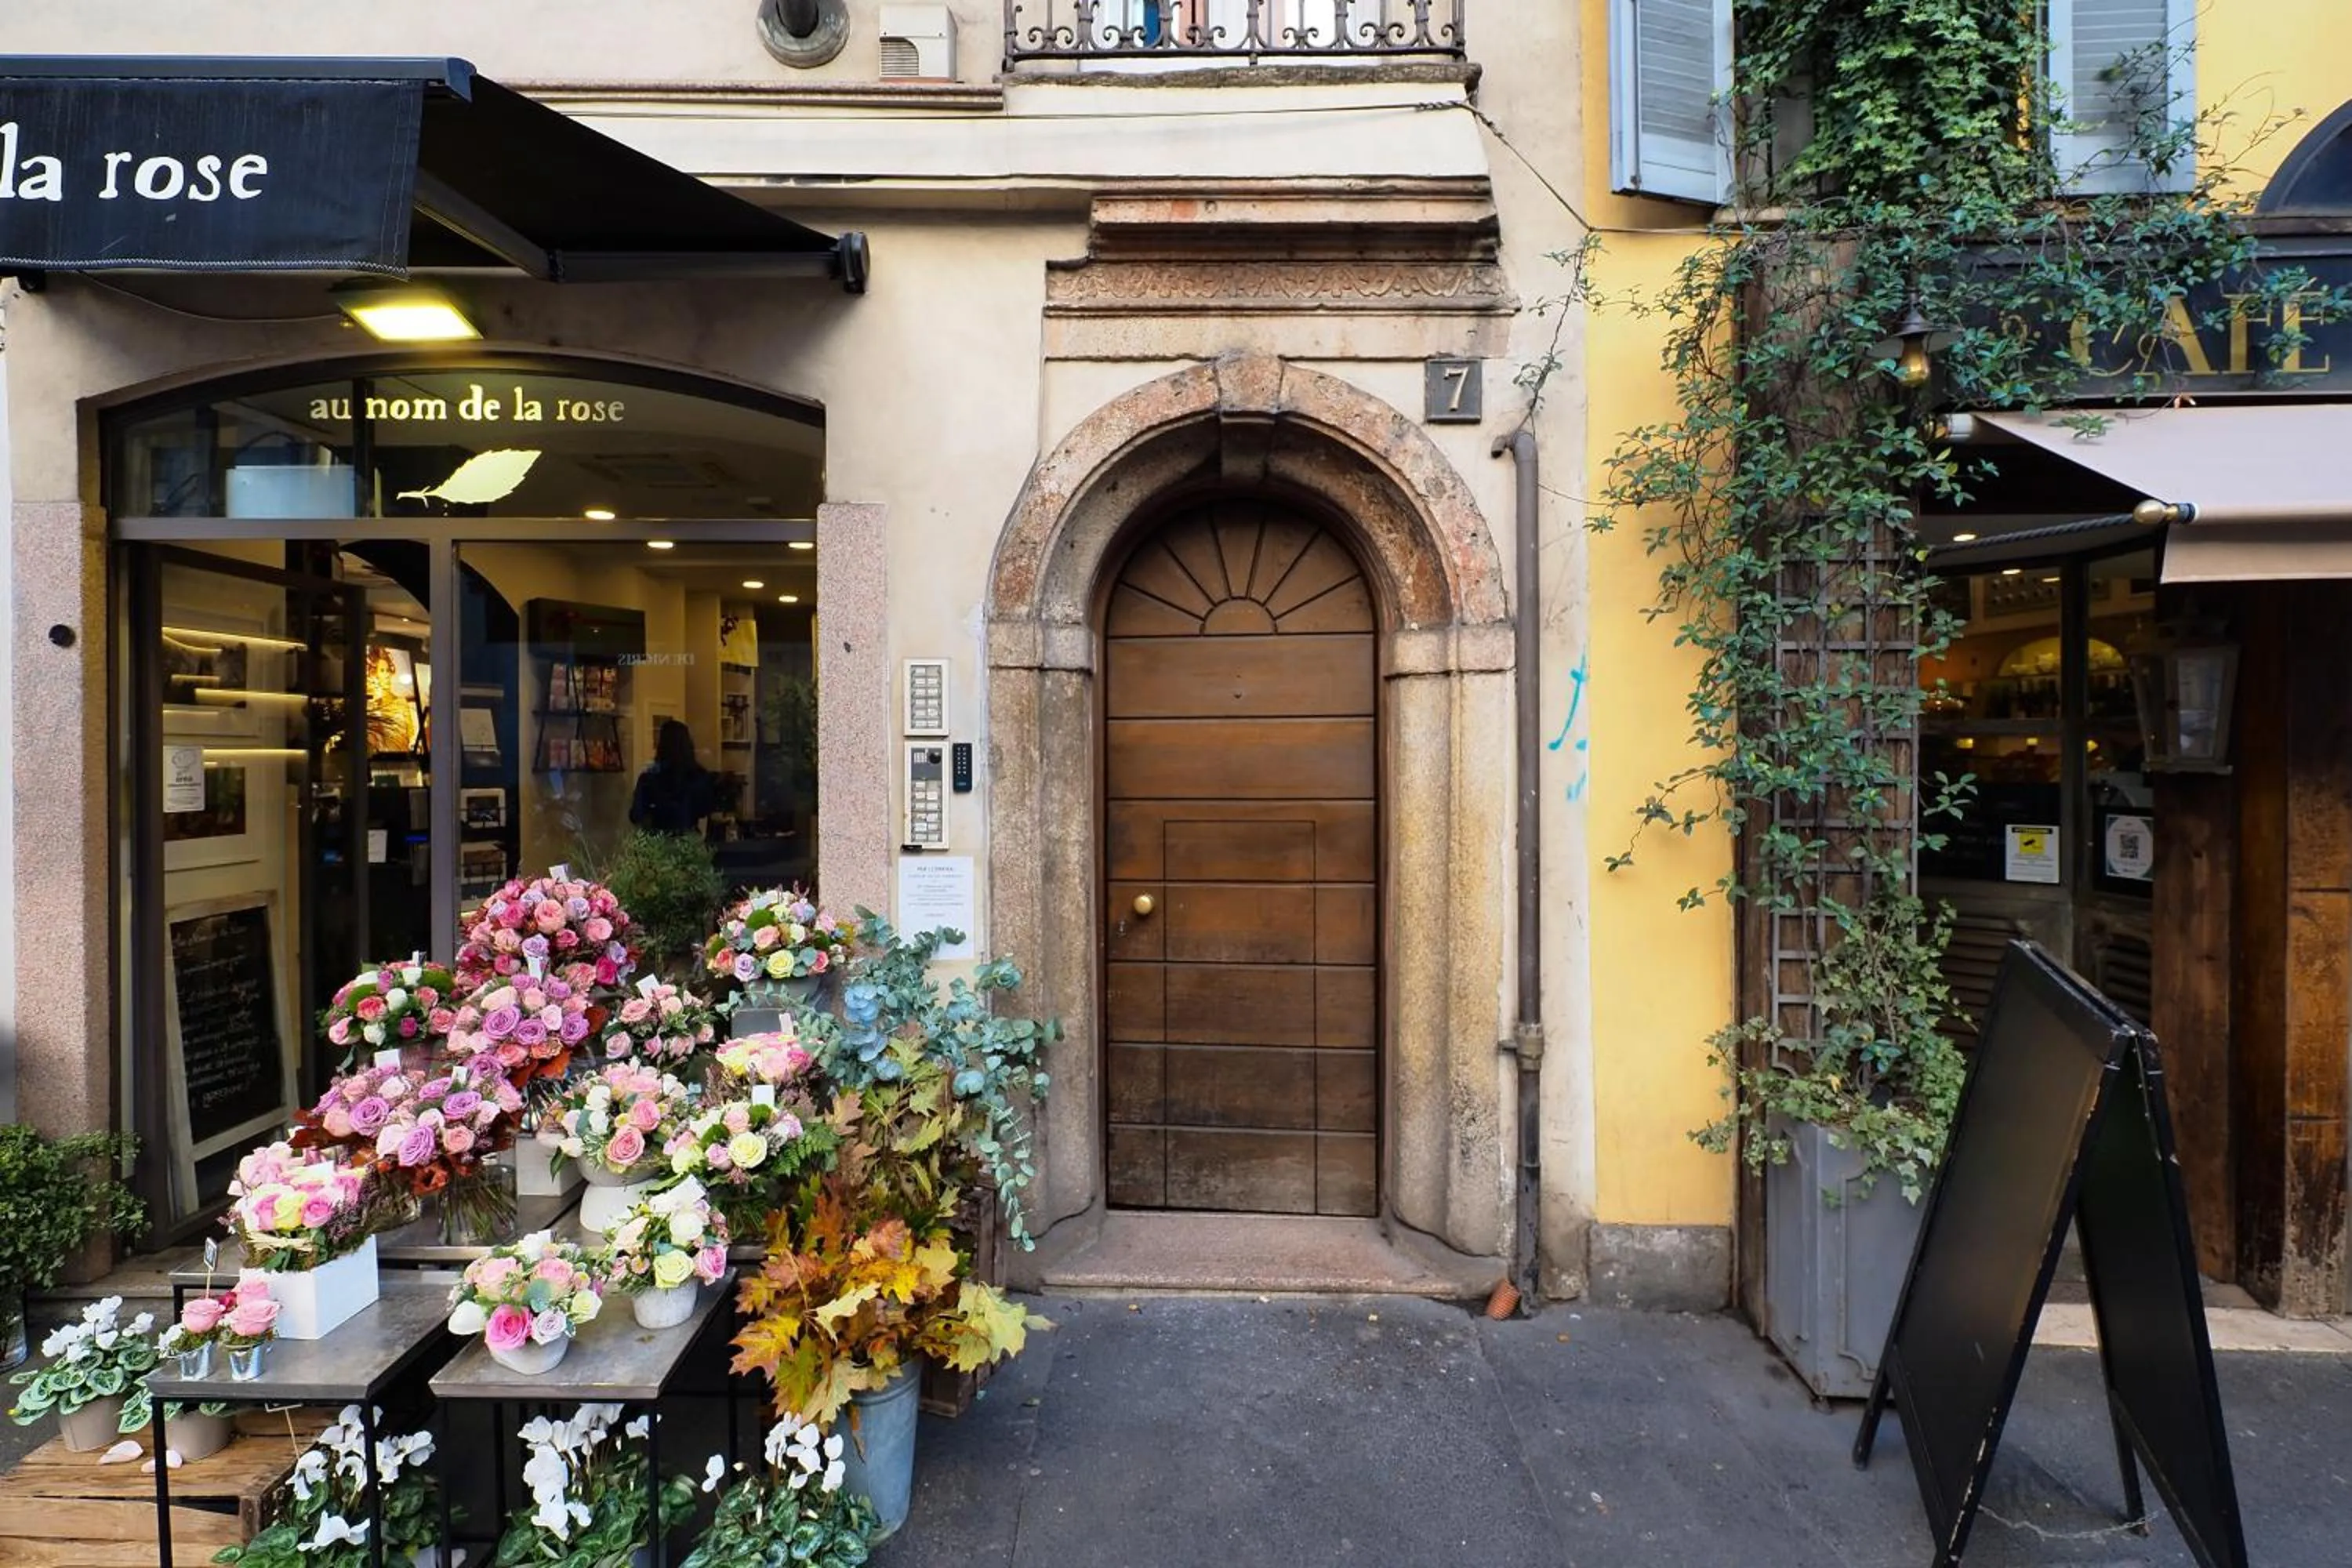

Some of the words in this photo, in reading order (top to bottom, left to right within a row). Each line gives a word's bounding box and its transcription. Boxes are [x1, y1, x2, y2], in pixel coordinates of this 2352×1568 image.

[98, 150, 268, 201] rose
[310, 397, 352, 420] au
[365, 397, 448, 420] nom
[458, 383, 502, 421] de
[514, 386, 543, 421] la
[555, 398, 626, 422] rose
[1444, 367, 1468, 411] 7
